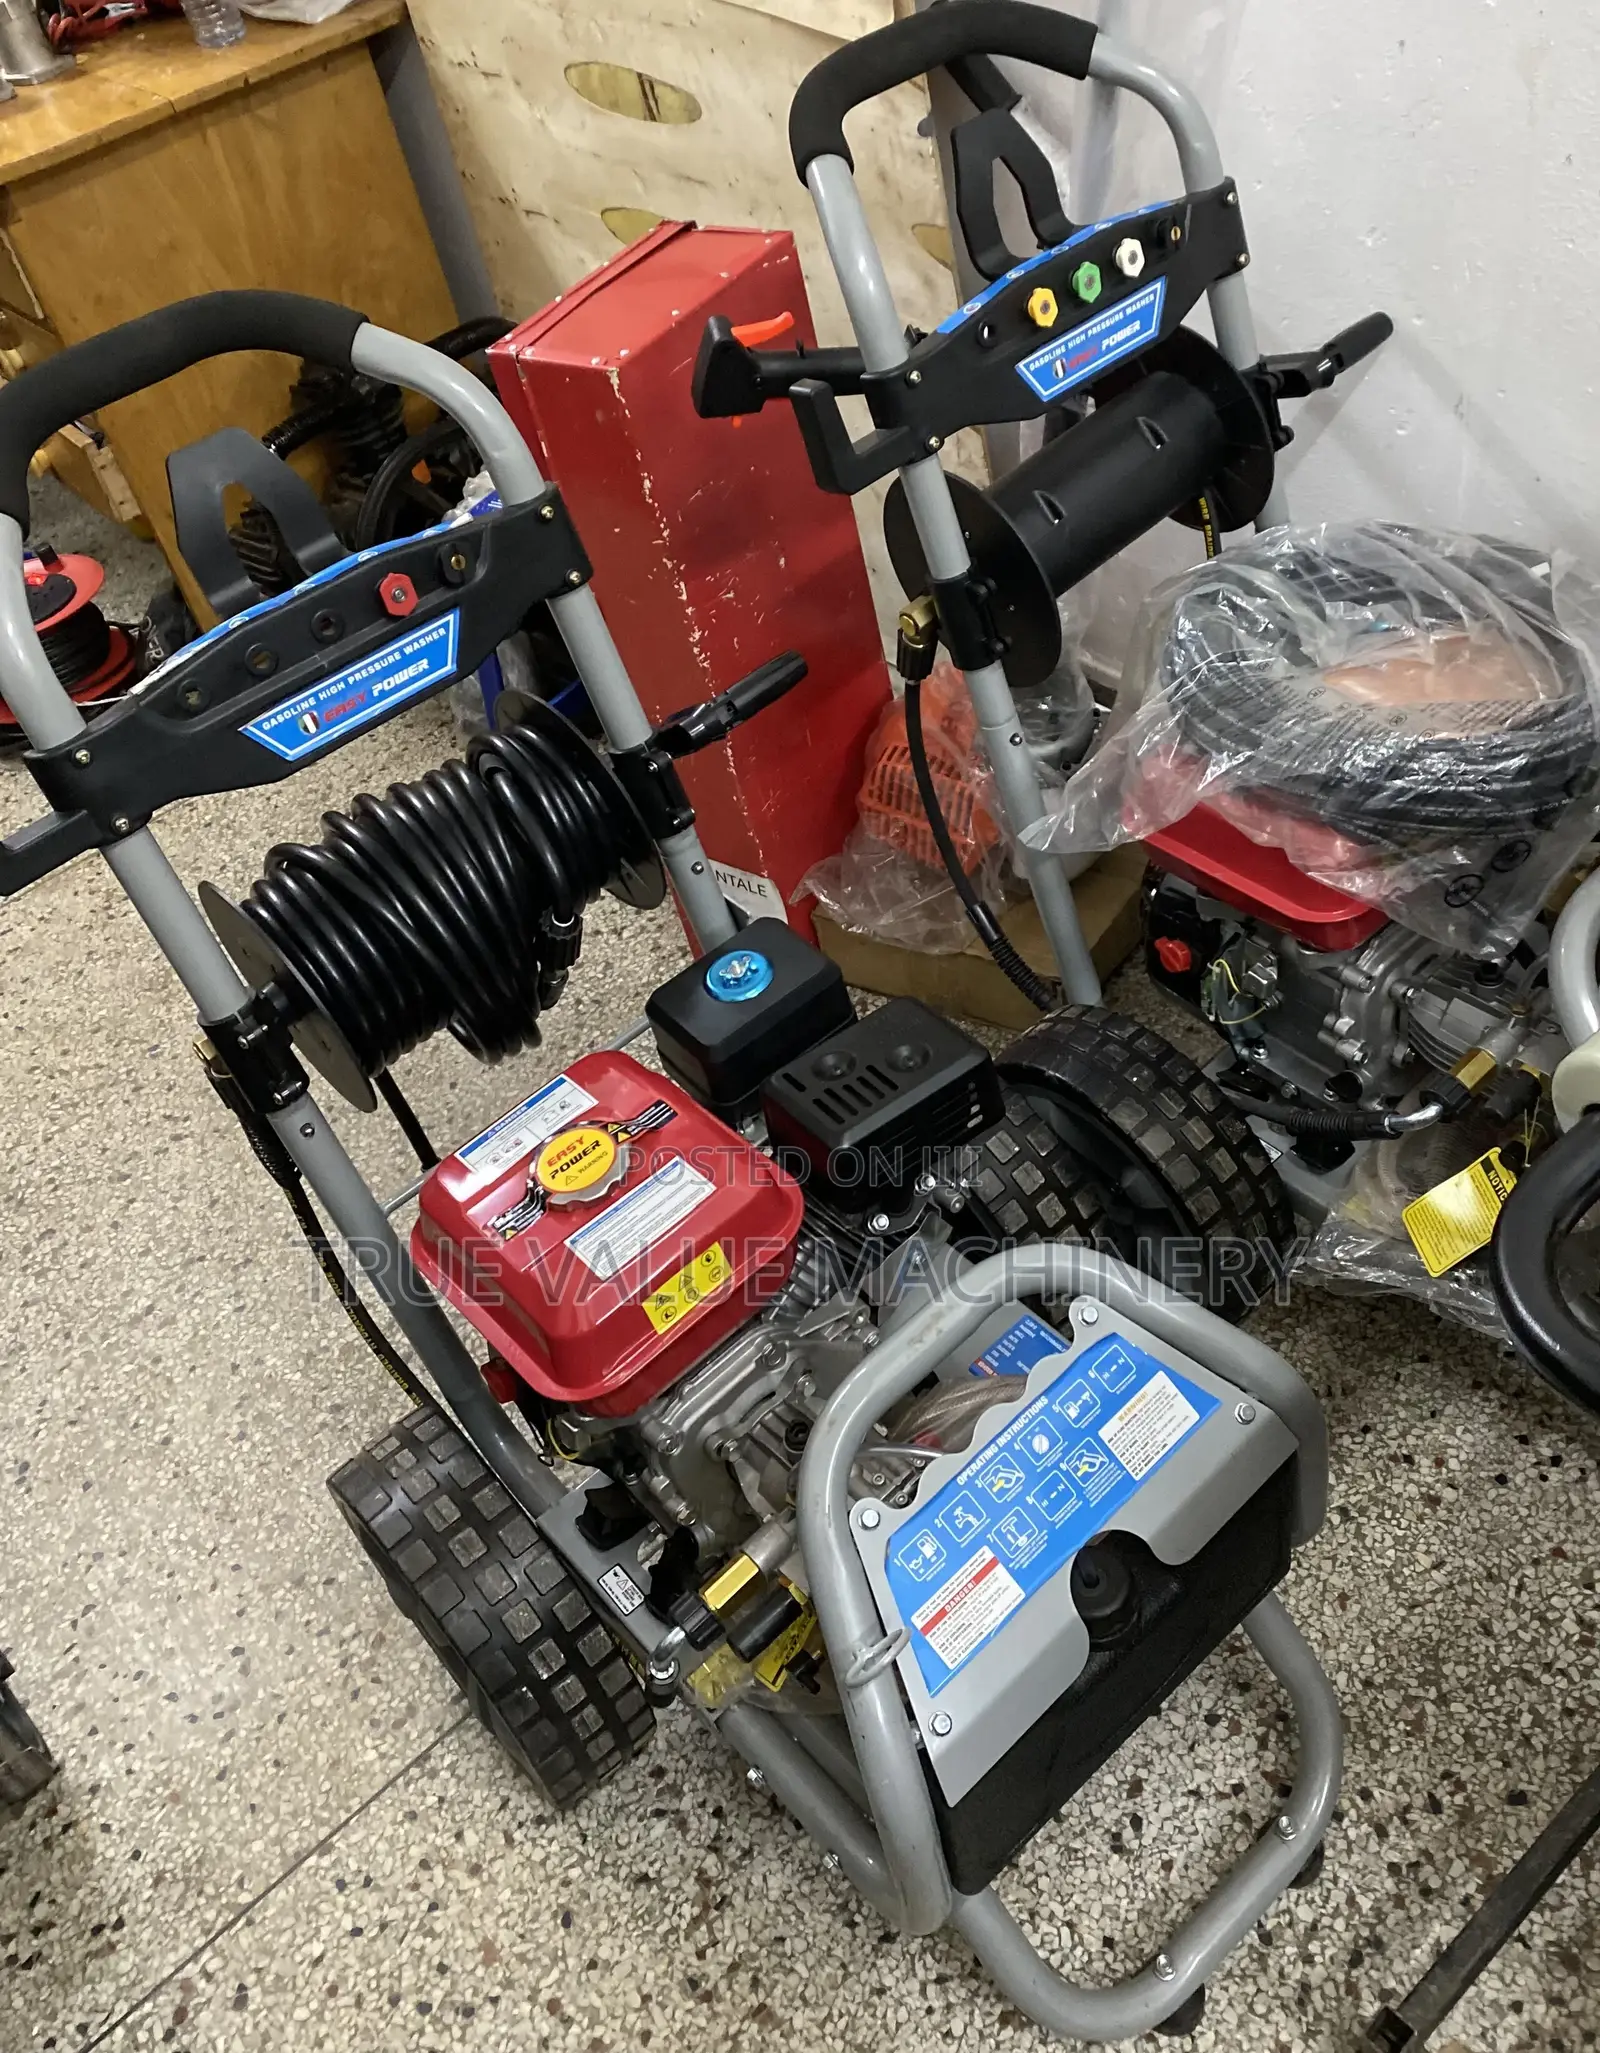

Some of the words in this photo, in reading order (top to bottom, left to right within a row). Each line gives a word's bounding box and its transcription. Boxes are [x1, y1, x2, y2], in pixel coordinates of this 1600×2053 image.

[1029, 344, 1067, 371] GASOLINE
[1068, 334, 1086, 350] HIGH
[1087, 311, 1124, 338] PRESSURE
[1125, 293, 1155, 315] WASHER
[1101, 319, 1141, 351] POWER
[1203, 524, 1215, 559] BRAIDE
[262, 697, 317, 732] GASOLINE
[318, 681, 346, 701] HIGH
[348, 654, 402, 686] PRESSURE
[402, 627, 447, 655] WASHER
[323, 689, 368, 723] EASY
[371, 657, 430, 697] POWER
[715, 869, 768, 898] NTALE
[546, 1135, 585, 1168] EASY
[549, 1139, 601, 1180] POWER
[577, 1150, 609, 1175] WARNING
[1487, 1169, 1508, 1201] NOTIC
[1051, 1404, 1060, 1413] 5
[956, 1443, 999, 1486] OPERATING
[996, 1395, 1049, 1448] INSTRUCTIONS
[1013, 1442, 1021, 1451] 4
[974, 1478, 983, 1488] 3
[934, 1518, 943, 1528] 2
[985, 1532, 995, 1544] 7
[893, 1557, 902, 1567] 1
[944, 1579, 977, 1613] DANGER!
